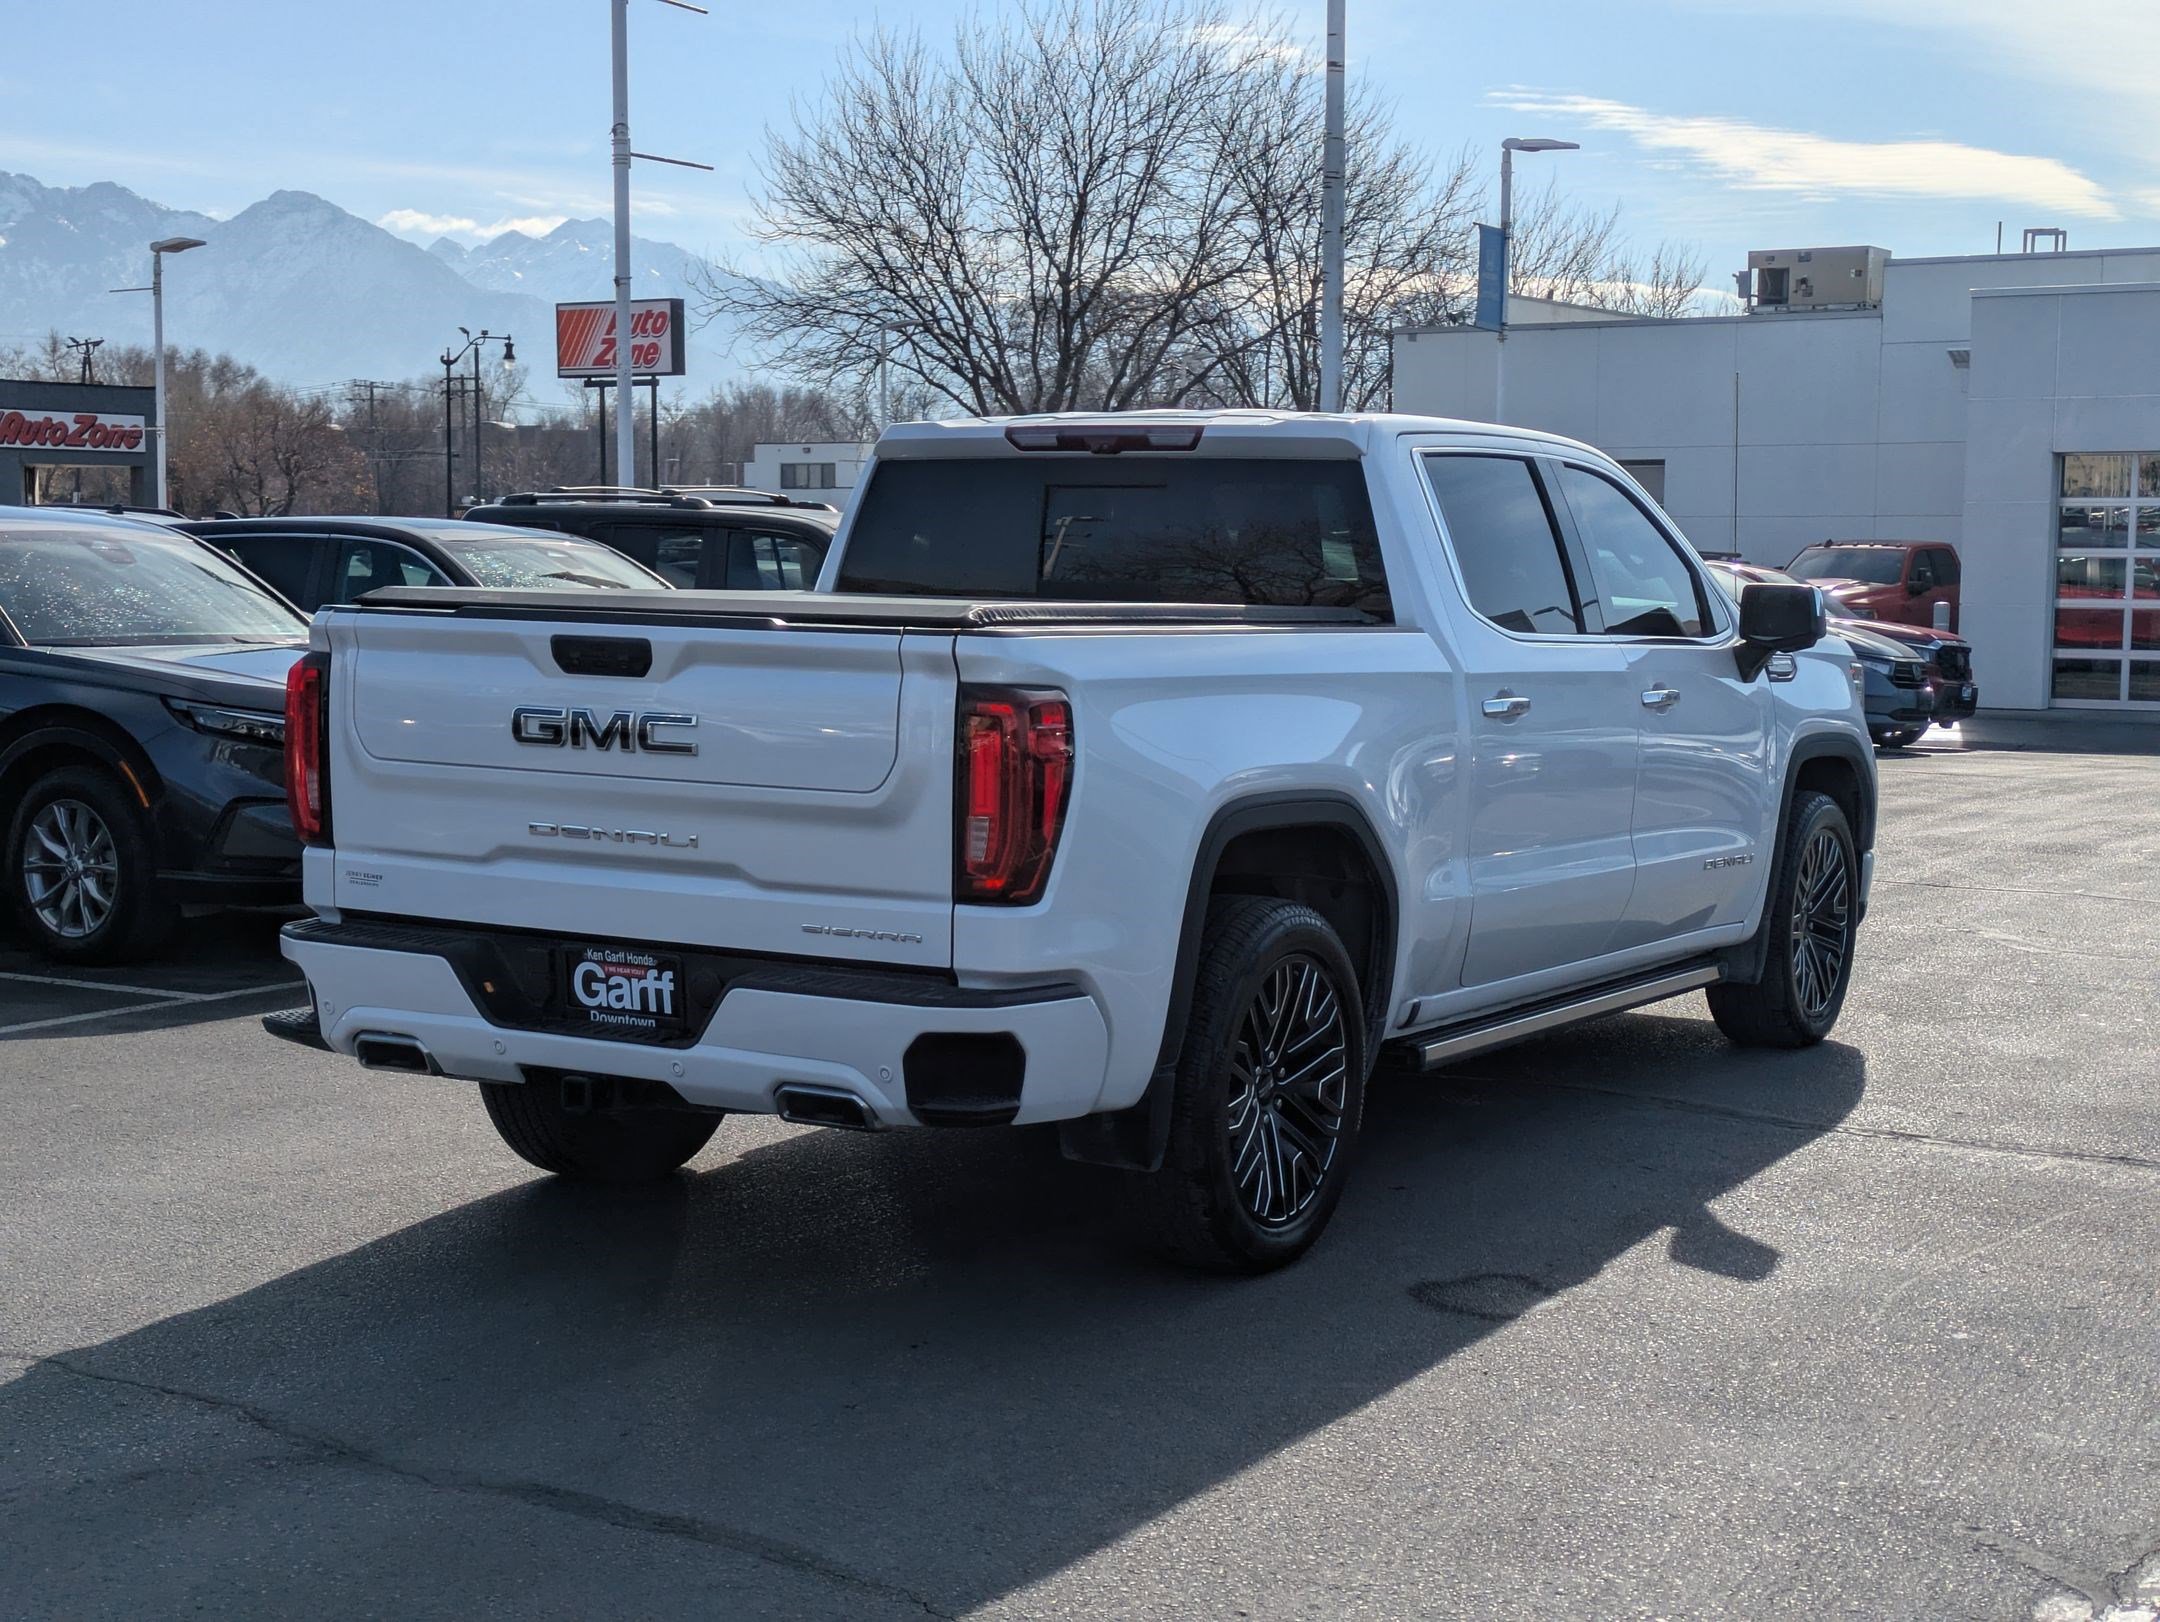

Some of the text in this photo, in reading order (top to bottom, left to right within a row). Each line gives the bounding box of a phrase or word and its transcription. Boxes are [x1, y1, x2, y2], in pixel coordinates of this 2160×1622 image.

[591, 337, 661, 369] Zne
[0, 411, 143, 449] AutoZone
[512, 704, 699, 757] GMC
[528, 821, 699, 849] DENALI
[1704, 852, 1755, 870] DENALI
[801, 923, 922, 944] SIERRA
[587, 948, 654, 966] Ken Garff Honda
[573, 961, 675, 1015] Garff
[590, 1010, 656, 1027] Downtown
